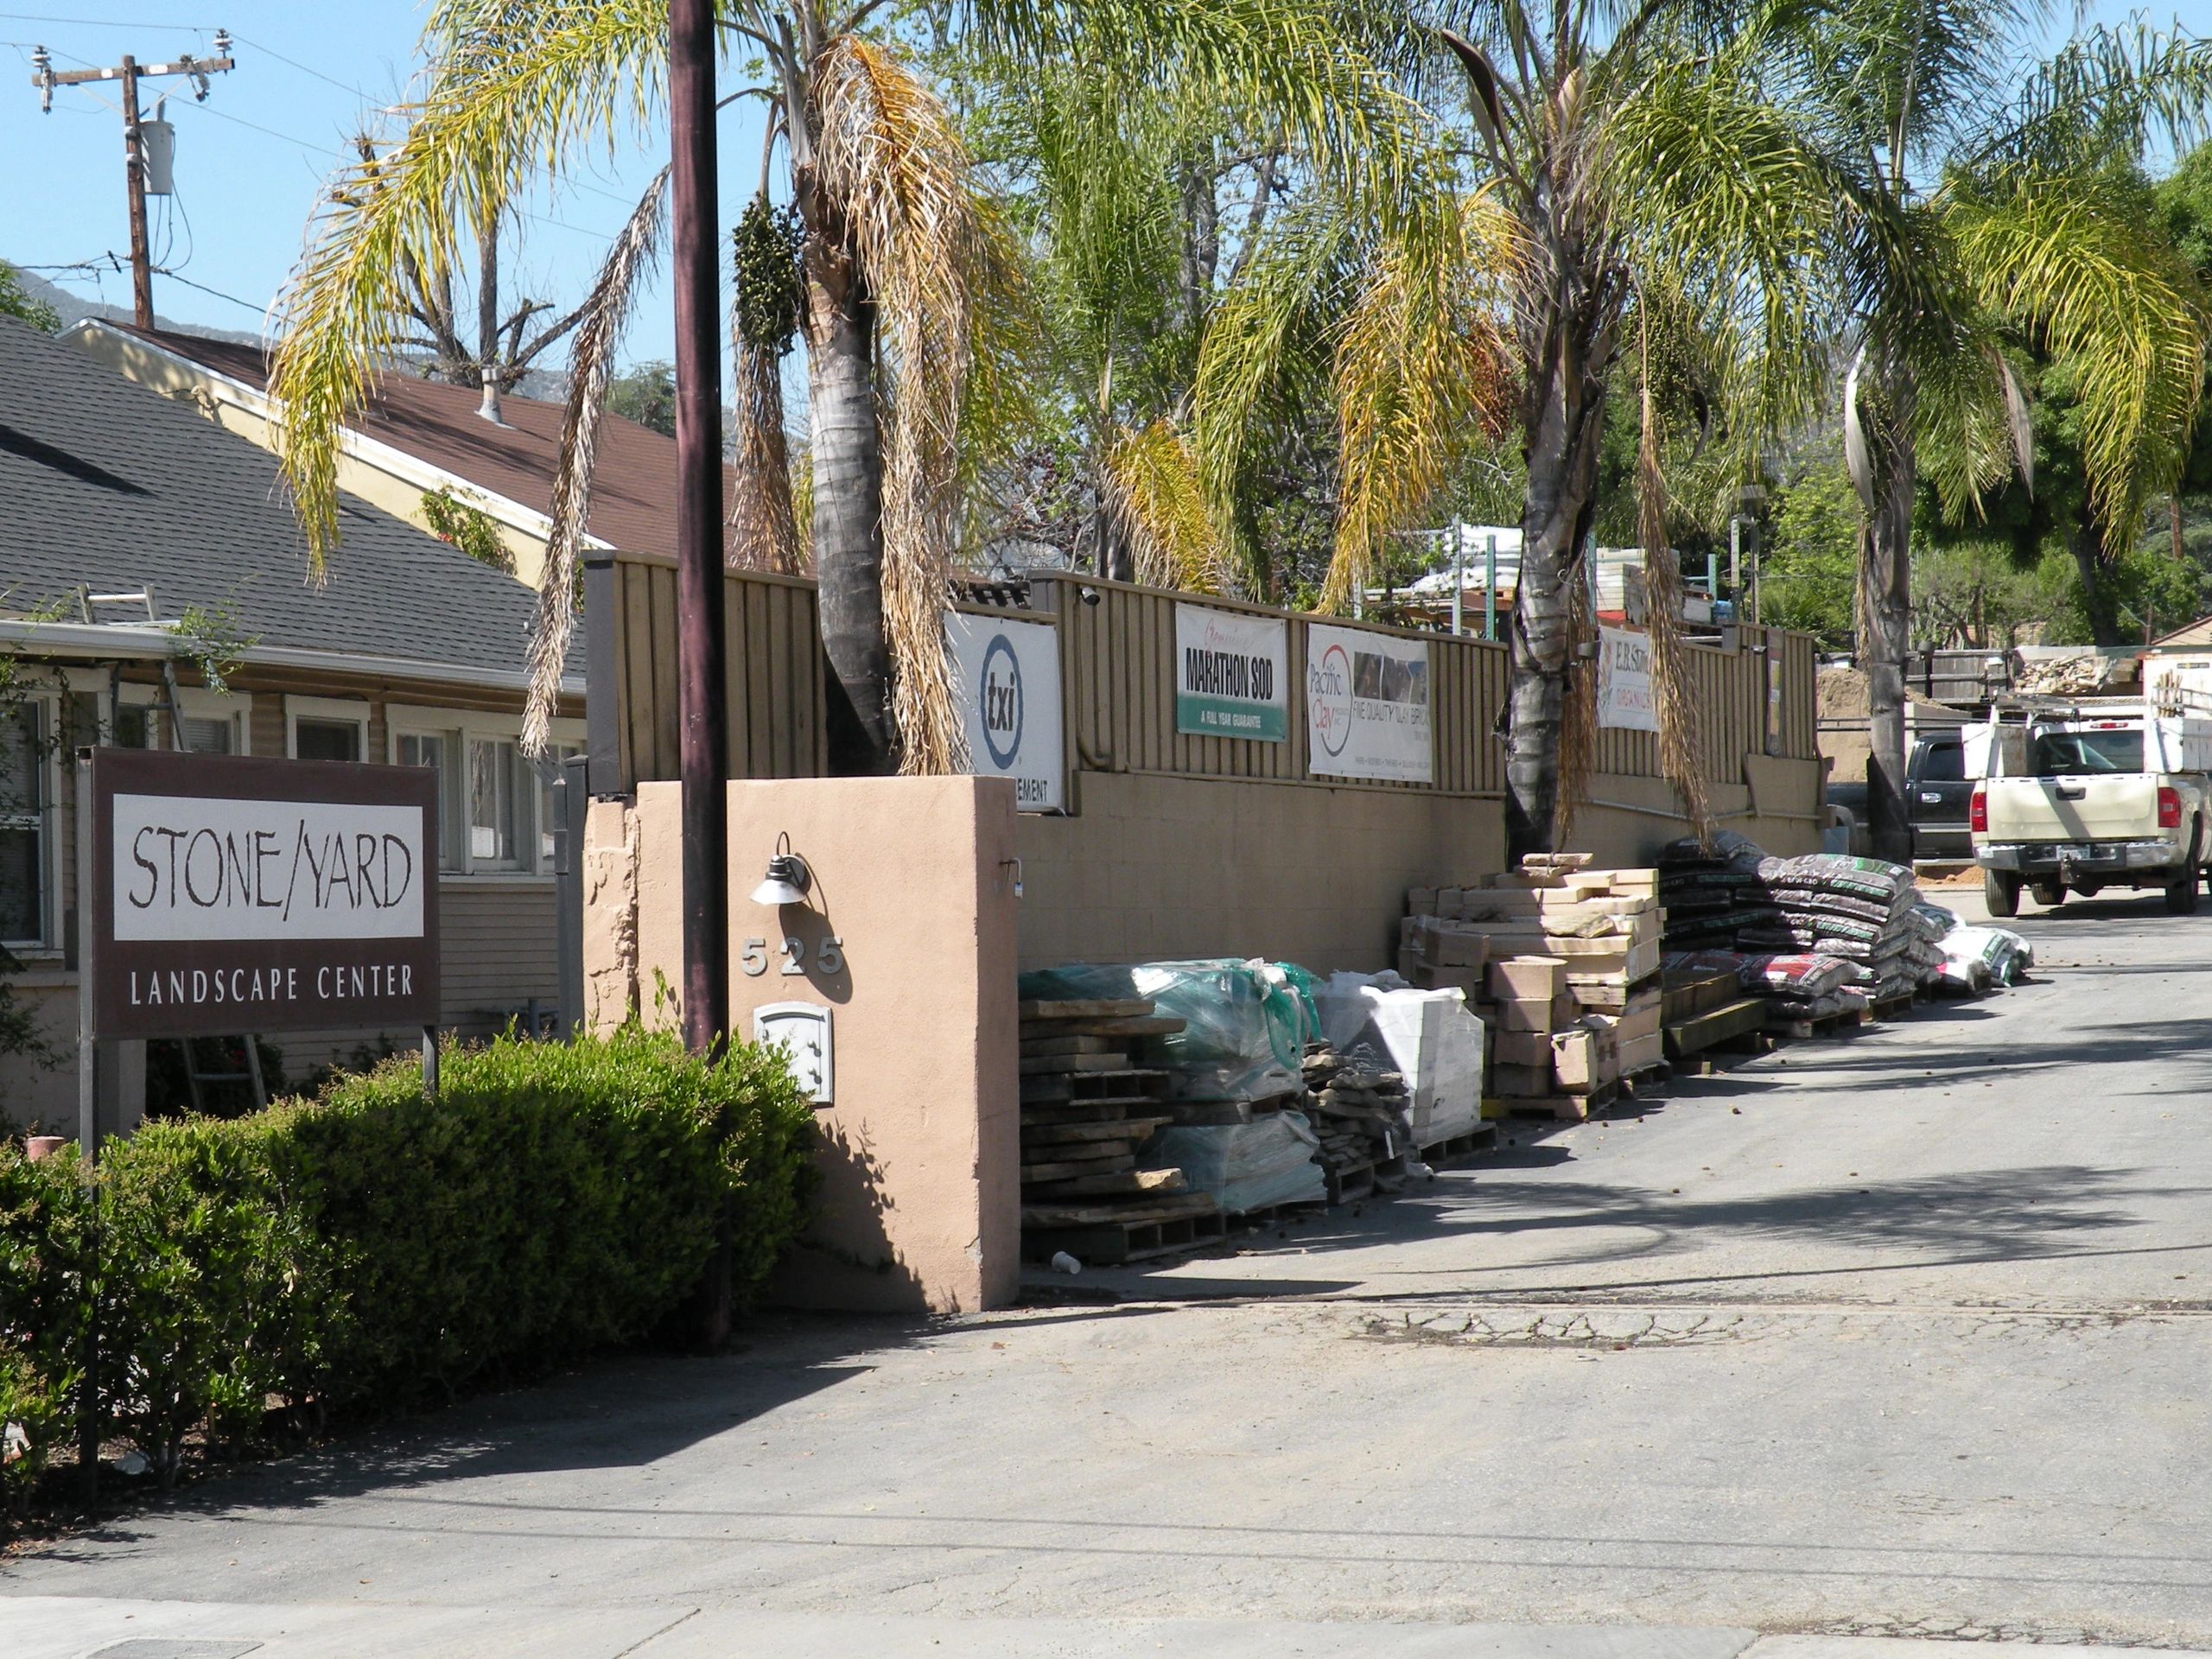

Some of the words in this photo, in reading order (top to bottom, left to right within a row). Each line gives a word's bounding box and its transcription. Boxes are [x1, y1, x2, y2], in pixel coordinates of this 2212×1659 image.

[1186, 647, 1249, 698] MARATHON
[1251, 657, 1274, 701] SOD
[1310, 663, 1342, 696] Pacific
[988, 671, 1014, 731] txi
[1200, 710, 1205, 725] A
[1206, 710, 1217, 726] FULL
[1218, 711, 1231, 727] YEAR
[1232, 713, 1262, 729] GUARANTEE
[1313, 696, 1335, 741] Clay
[1367, 701, 1395, 722] QUALITY
[1018, 778, 1048, 803] EMENT
[741, 937, 844, 976] 525
[130, 968, 297, 1006] LANDSCAPE
[316, 963, 413, 999] CENTER
